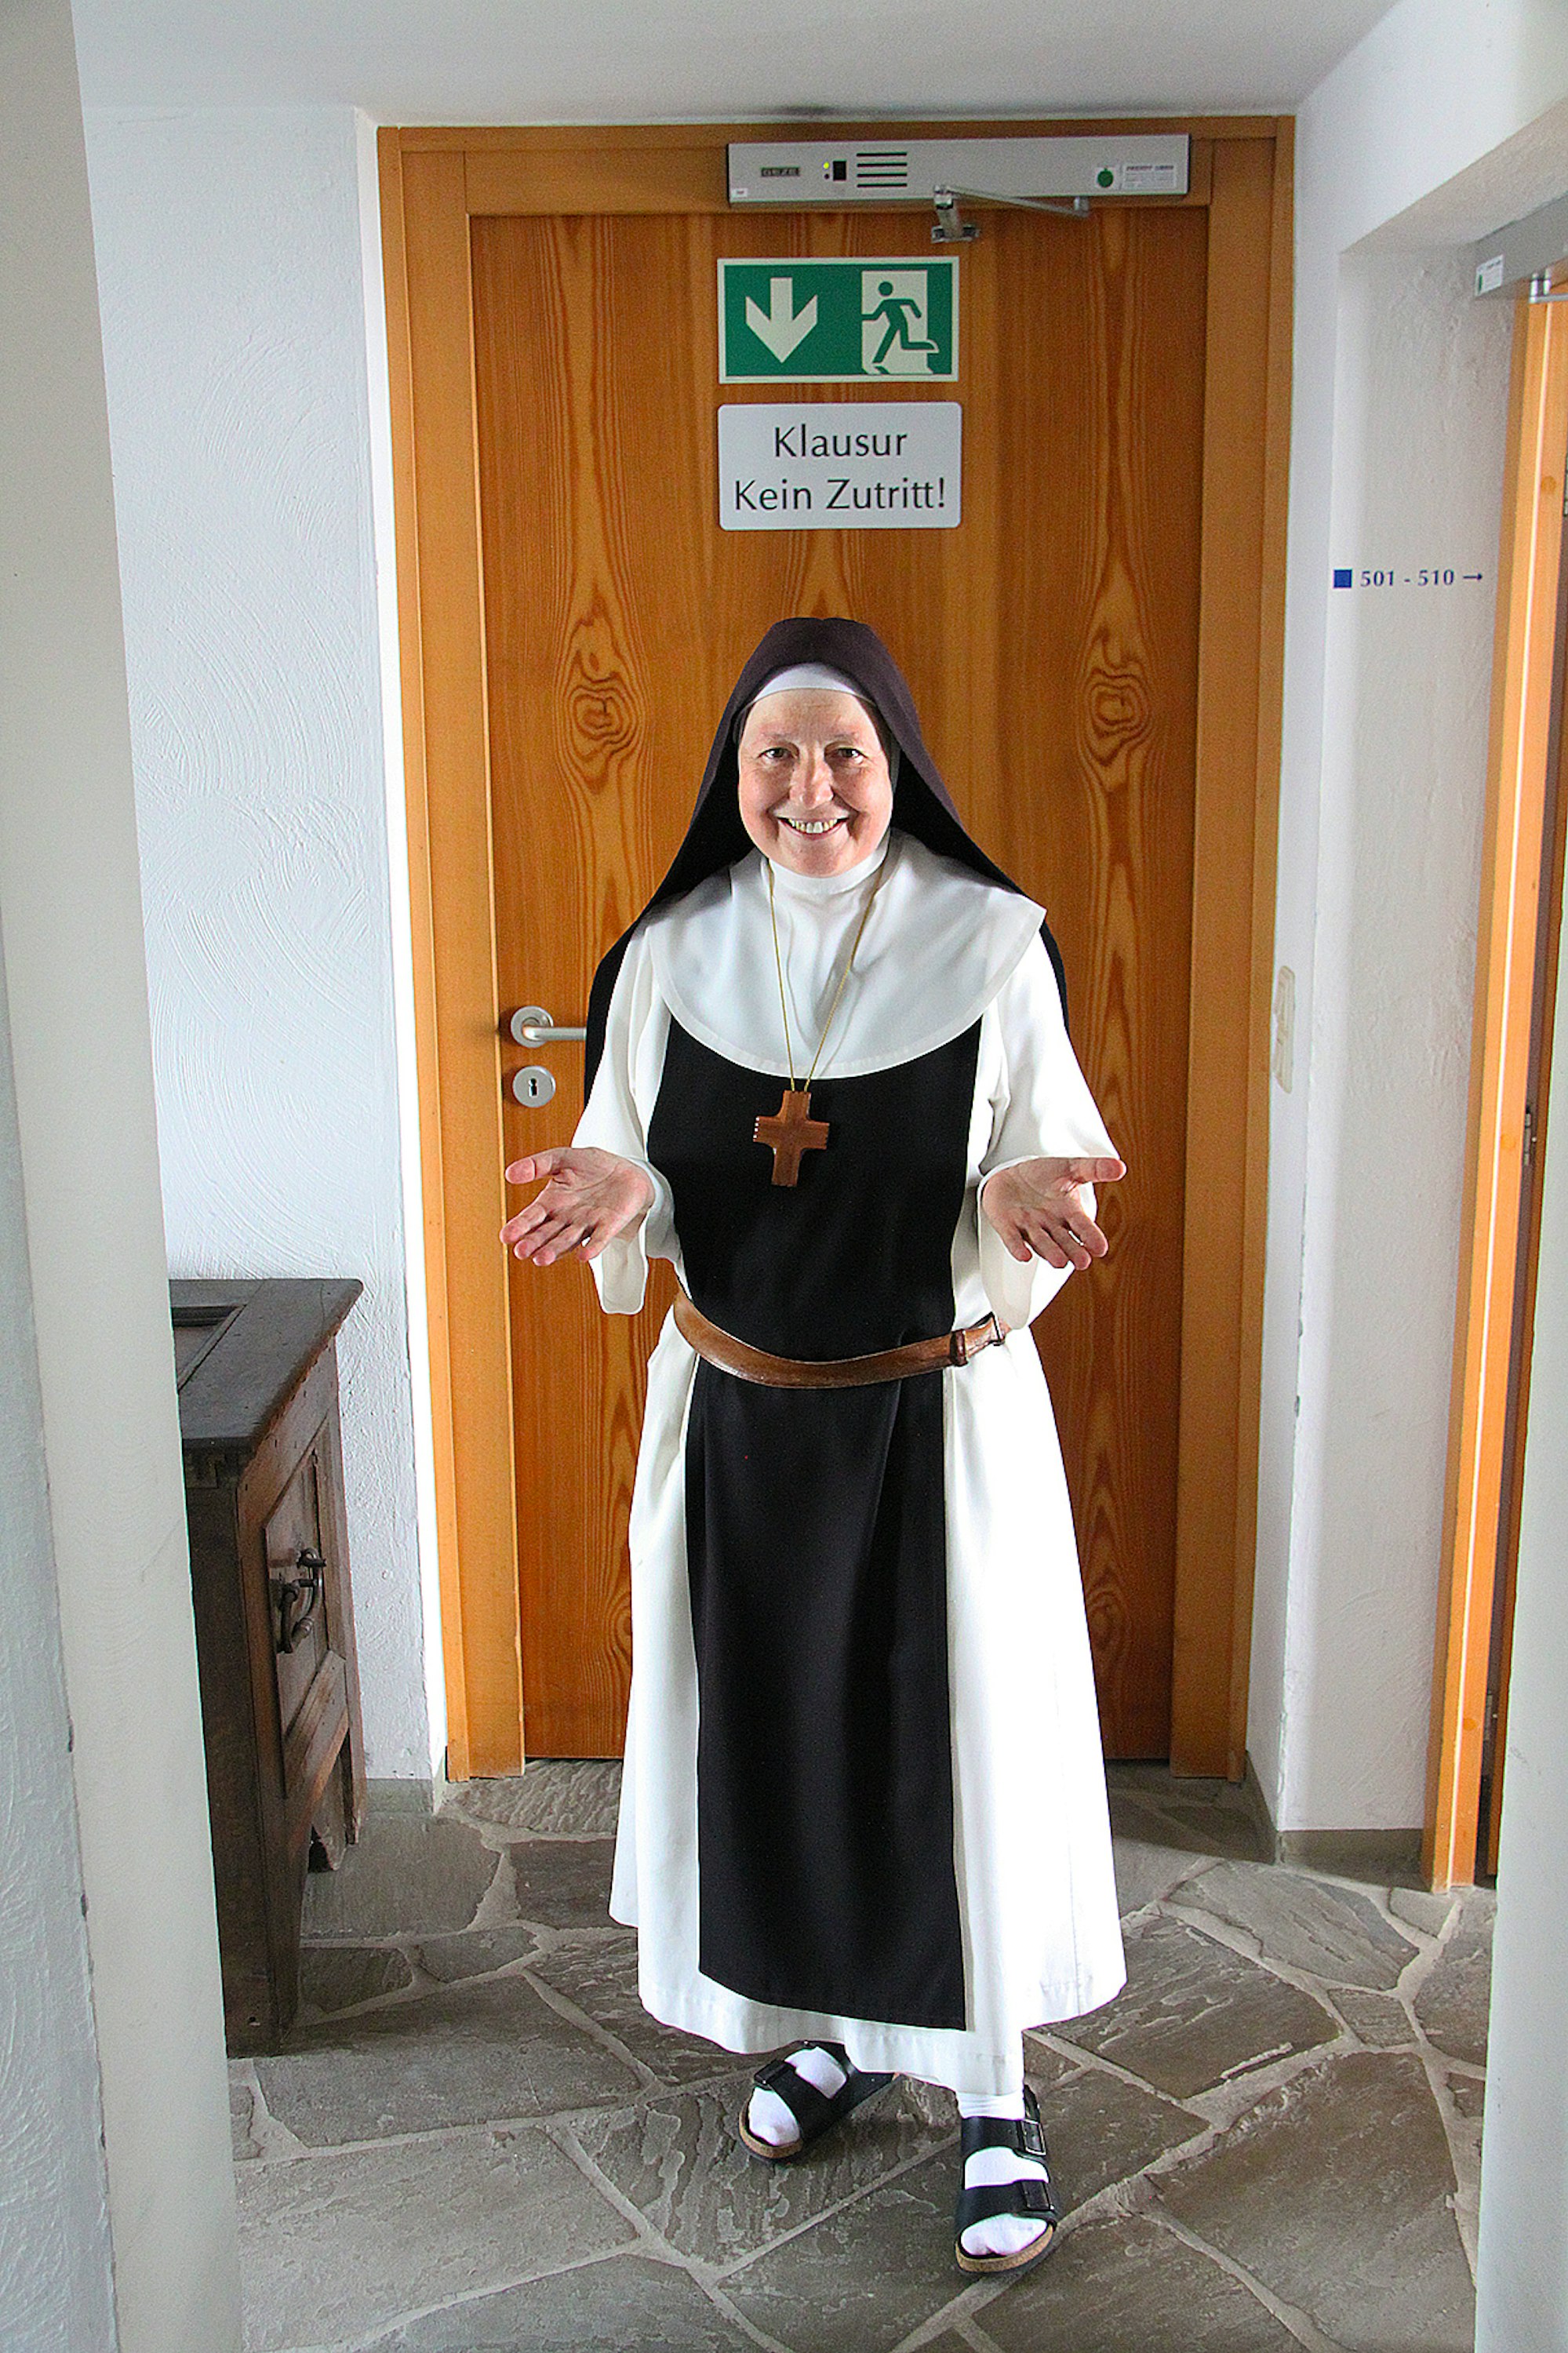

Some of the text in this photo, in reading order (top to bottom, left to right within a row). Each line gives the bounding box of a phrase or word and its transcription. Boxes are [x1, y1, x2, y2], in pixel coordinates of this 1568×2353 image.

[774, 424, 908, 457] Klausur
[735, 477, 944, 511] Kein Zutritt!
[1360, 570, 1394, 587] 501
[1417, 569, 1454, 586] 510
